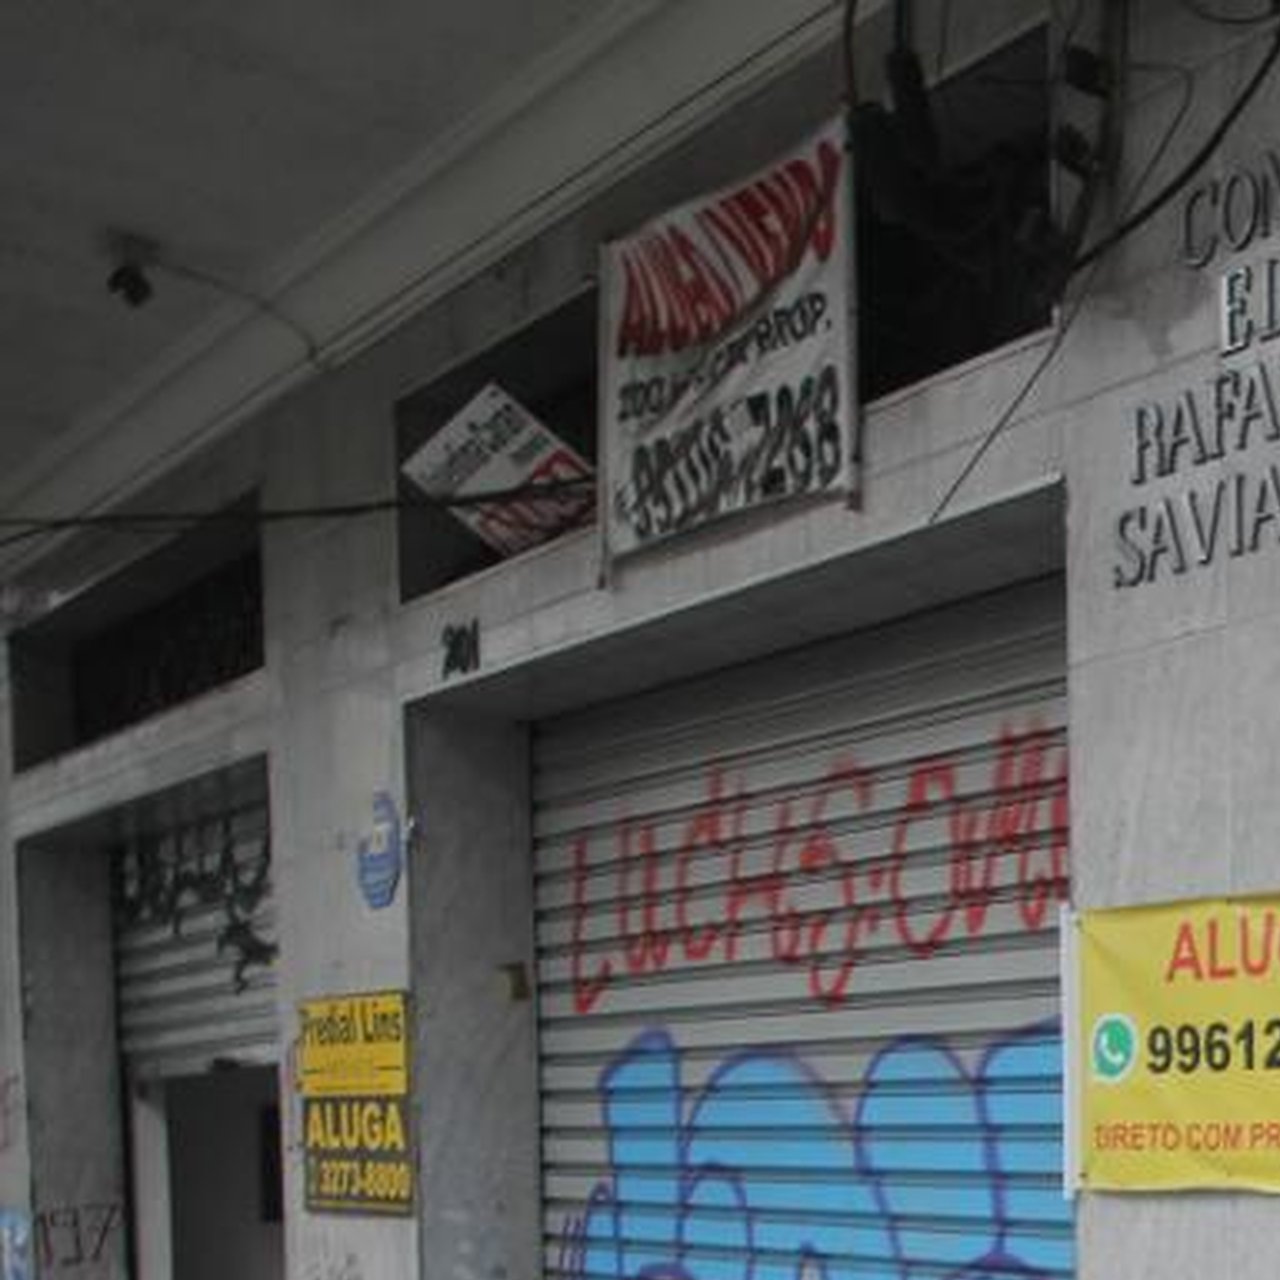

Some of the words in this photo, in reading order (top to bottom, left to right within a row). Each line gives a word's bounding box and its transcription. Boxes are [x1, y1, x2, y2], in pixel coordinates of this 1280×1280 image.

[308, 1102, 405, 1150] ALUGA
[1095, 1122, 1180, 1152] DIRETO
[1186, 1122, 1243, 1151] COM
